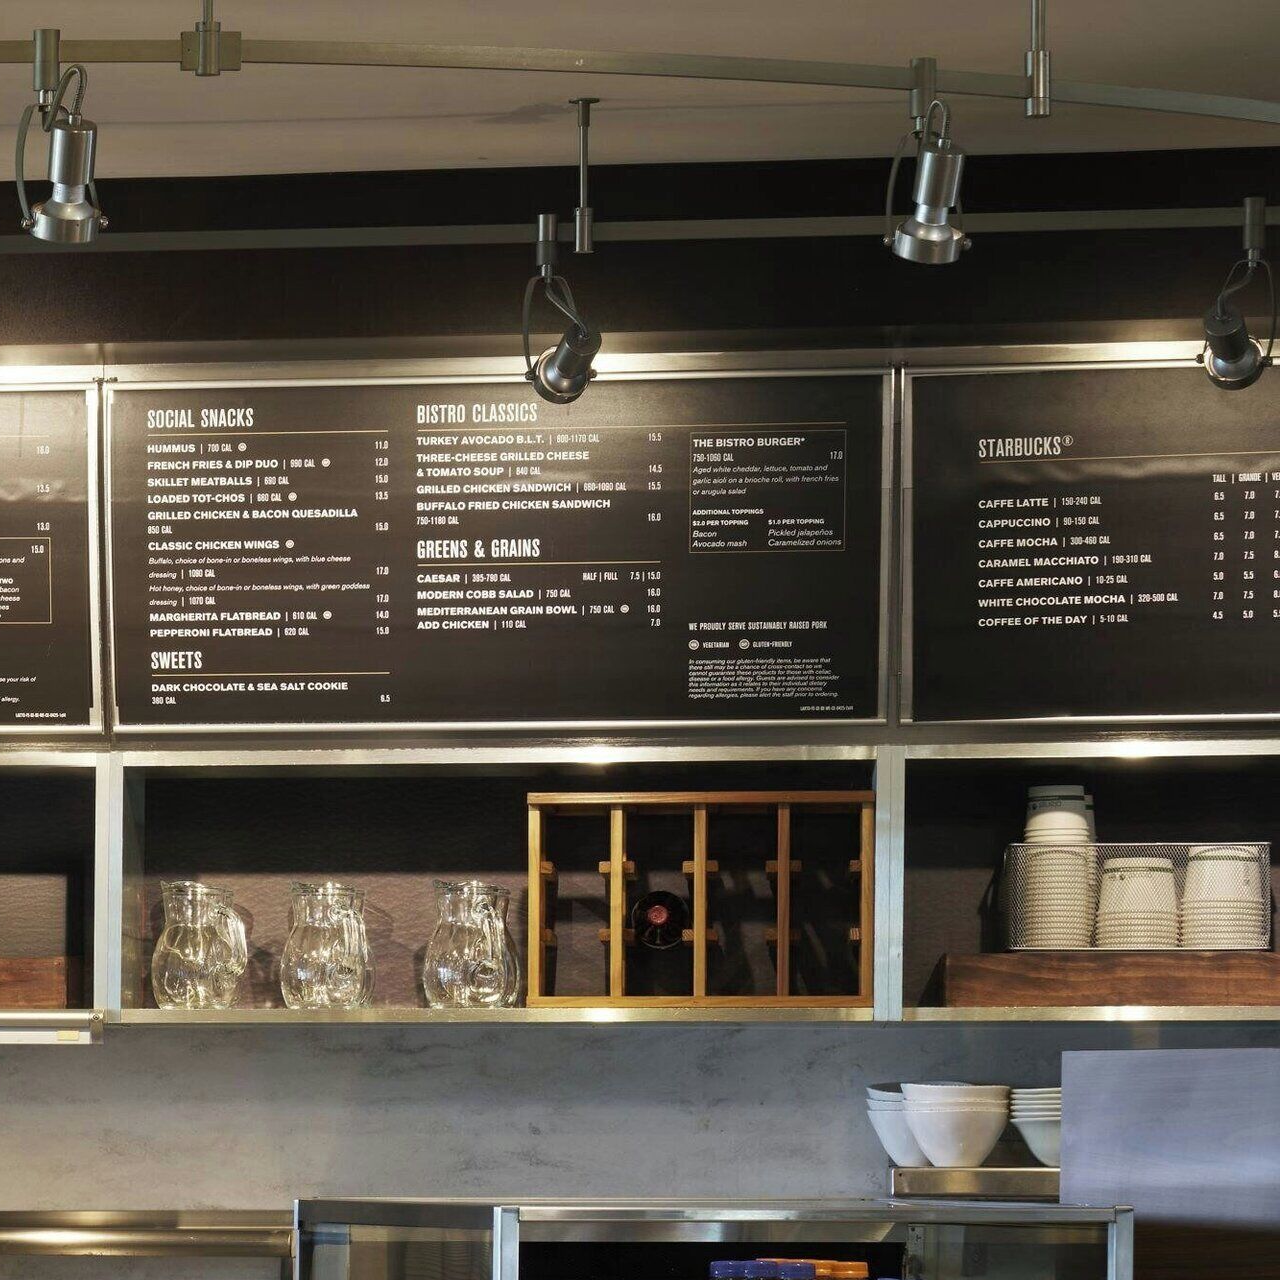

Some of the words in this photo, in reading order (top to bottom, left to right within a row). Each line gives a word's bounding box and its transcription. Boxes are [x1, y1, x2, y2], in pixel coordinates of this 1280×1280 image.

[147, 409, 194, 428] SOCIAL
[201, 408, 254, 427] SNACKS
[417, 404, 466, 424] BISTRO
[472, 403, 537, 422] CLASSICS
[417, 436, 459, 445] TURKEY
[461, 436, 514, 445] AVOCADO
[517, 435, 544, 444] B.L.T.
[648, 433, 662, 442] 15.5
[693, 439, 713, 447] THE
[716, 438, 755, 447] BISTRO
[147, 444, 195, 453] HUMMUS
[417, 453, 498, 462] THREE-CHEESE
[500, 452, 544, 461] GRILLED
[546, 451, 589, 460] CHEESE
[147, 461, 190, 470] FRENCH
[192, 460, 223, 469] FRIES
[225, 460, 233, 469] &
[235, 460, 253, 469] DIP
[255, 460, 278, 468] DUO
[649, 464, 662, 473] 14.5
[417, 468, 424, 477] &
[426, 468, 471, 477] TOMATO
[474, 467, 504, 476] SOUP
[147, 478, 189, 487] SKILLET
[191, 477, 252, 486] MEATBALLS
[648, 481, 662, 491] 15.5
[417, 485, 461, 494] GRILLED
[463, 484, 510, 494] CHICKEN
[512, 483, 571, 492] SANDWICH
[147, 495, 190, 504] LOADED
[192, 494, 245, 503] TOT-CHOS
[375, 491, 389, 501] 13.5
[417, 502, 466, 511] BUFFALO
[468, 501, 500, 511] FRIED
[502, 500, 550, 510] CHICKEN
[552, 499, 611, 509] SANDWICH
[978, 499, 1013, 509] CAFFE
[1017, 498, 1049, 508] LATTE
[147, 511, 191, 520] GRILLED
[193, 510, 241, 520] CHICKEN
[242, 510, 250, 519] &
[252, 510, 289, 519] BACON
[292, 509, 358, 518] QUESADILLA
[978, 518, 1051, 529] CAPPUCCINO
[148, 541, 193, 551] CLASSIC
[195, 541, 241, 550] CHICKEN
[243, 540, 280, 549] WINGS
[978, 538, 1013, 549] CAFFE
[1017, 537, 1058, 548] MOCHA
[417, 540, 467, 559] GREENS
[474, 540, 485, 558] &
[491, 538, 540, 557] GRAINS
[978, 558, 1031, 569] CARAMEL
[1033, 556, 1099, 567] MACCHIATO
[417, 574, 460, 583] CAESAR
[582, 573, 598, 581] HALF
[604, 572, 618, 581] FULL
[630, 572, 641, 580] 7.5
[1243, 571, 1254, 579] 5.5
[978, 578, 1013, 589] CAFFE
[1016, 576, 1083, 587] AMERICANO
[417, 590, 464, 600] MODERN
[466, 590, 496, 599] COBB
[499, 589, 534, 599] SALAD
[1243, 591, 1254, 599] 7.5
[978, 598, 1013, 608] WHITE
[1015, 596, 1082, 607] CHOCOLATE
[1084, 594, 1126, 605] MOCHA
[417, 606, 508, 616] MEDITERRANEAN
[510, 605, 544, 615] GRAIN
[546, 605, 577, 615] BOWL
[1213, 611, 1223, 619] 4.5
[149, 612, 219, 622] MARGHERITA
[220, 612, 281, 621] FLATBREAD
[978, 617, 1021, 628] COFFEE
[1024, 616, 1039, 627] OF
[1041, 616, 1063, 626] THE
[1065, 615, 1088, 626] DAY
[417, 621, 440, 630] ADD
[442, 620, 489, 629] CHICKEN
[150, 629, 210, 638] PEPPERONI
[212, 628, 273, 637] FLATBREAD
[151, 651, 203, 670] SWEETS
[152, 684, 181, 692] DARK
[183, 683, 246, 692] CHOCOLATE
[247, 683, 255, 691] &
[257, 683, 278, 691] SEA
[280, 683, 306, 691] SALT
[307, 682, 348, 691] COOKIE
